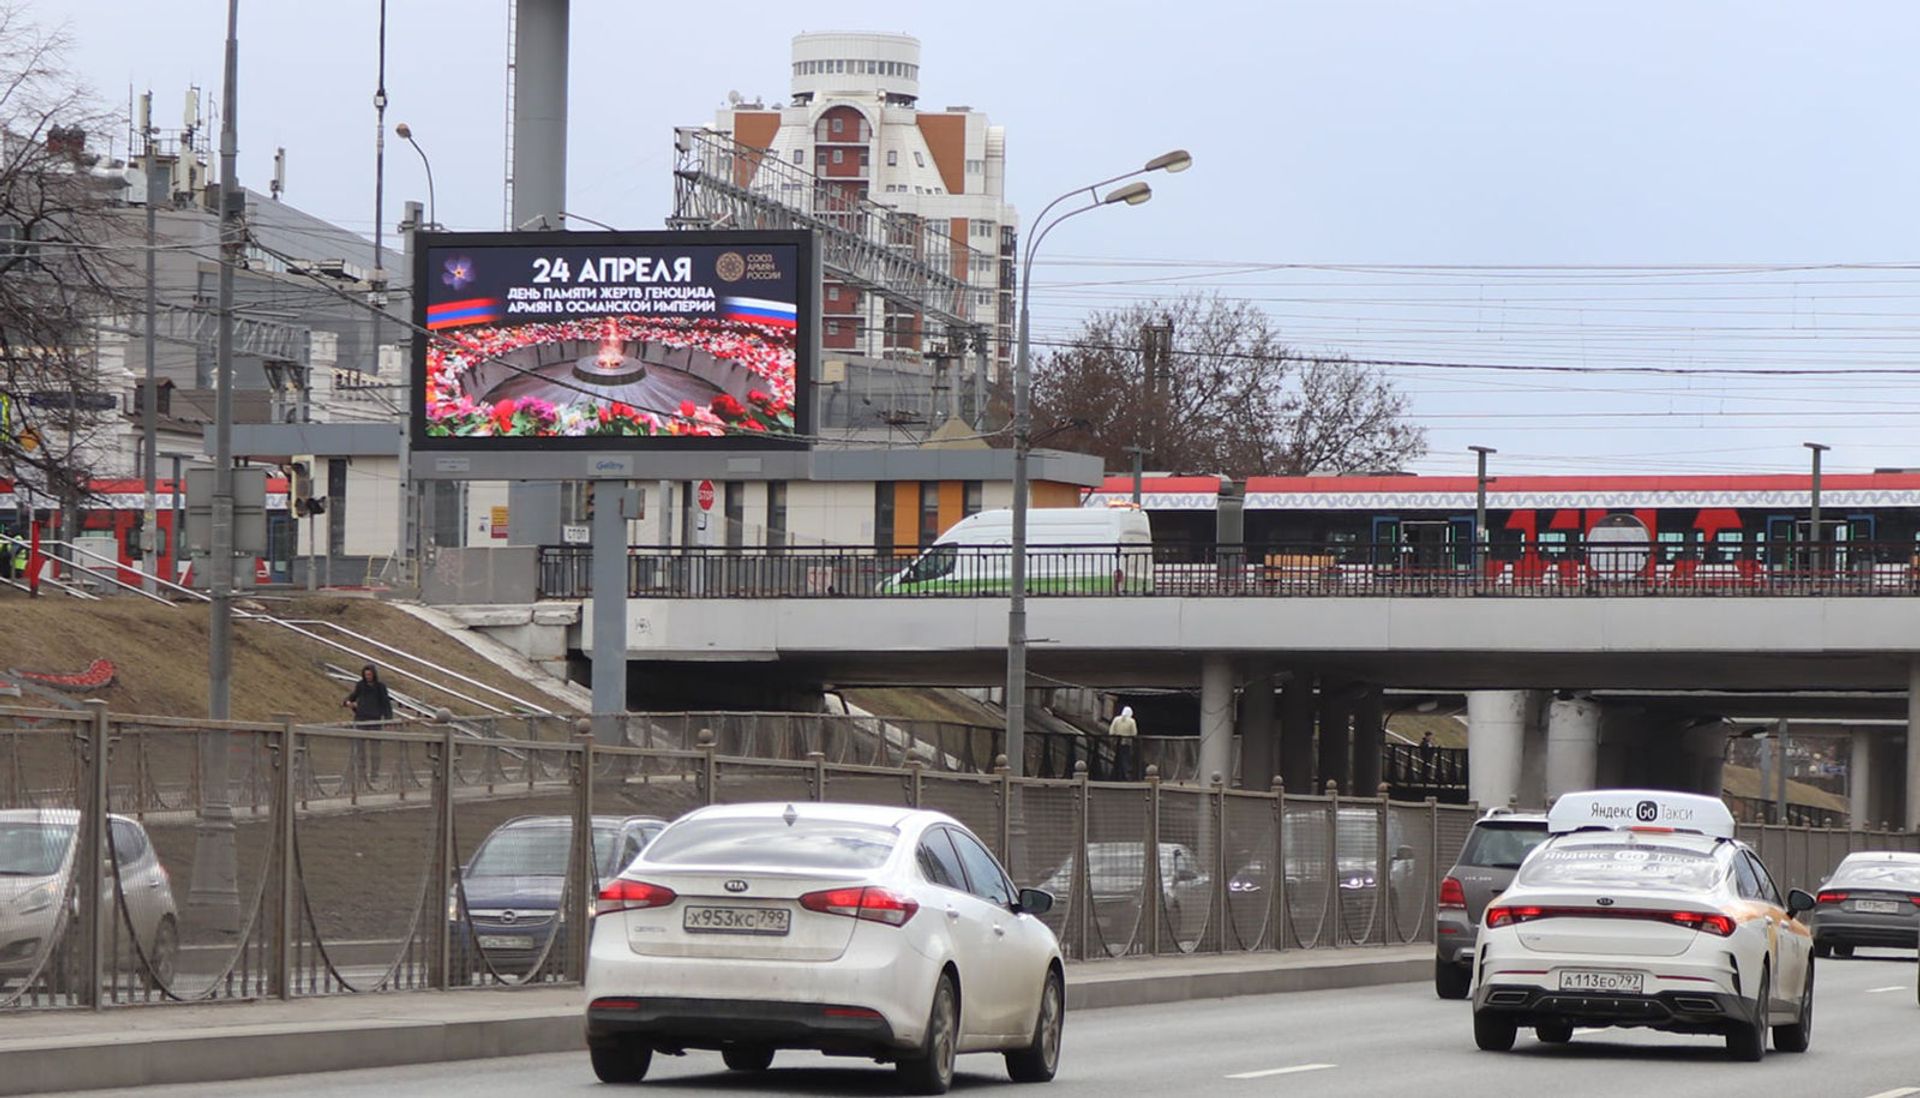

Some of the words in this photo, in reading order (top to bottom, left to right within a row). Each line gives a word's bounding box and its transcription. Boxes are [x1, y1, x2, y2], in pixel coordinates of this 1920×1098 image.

[532, 257, 571, 283] 24
[577, 257, 692, 283] АПРЕЛЯ
[746, 271, 781, 280] РОССИИ
[507, 287, 541, 299] ДЕНЬ
[543, 287, 597, 299] ПАМЯТИ
[600, 287, 642, 298] ЖЕРТВ
[644, 287, 715, 300] ГЕНОЦИДА
[507, 301, 552, 313] АРМЯН
[554, 301, 564, 312] В
[565, 300, 651, 312] ОСМАНСКОЙ
[653, 301, 716, 312] ИМПЕРИИ
[698, 489, 713, 501] STOP
[1591, 802, 1632, 819] Яндекс
[1639, 803, 1656, 820] Go
[1661, 804, 1693, 820] Такси
[727, 882, 746, 890] KIA
[691, 910, 754, 927] Х953КС
[759, 911, 784, 924] 799
[1564, 974, 1617, 988] А113ЕО
[1619, 976, 1640, 986] 797
